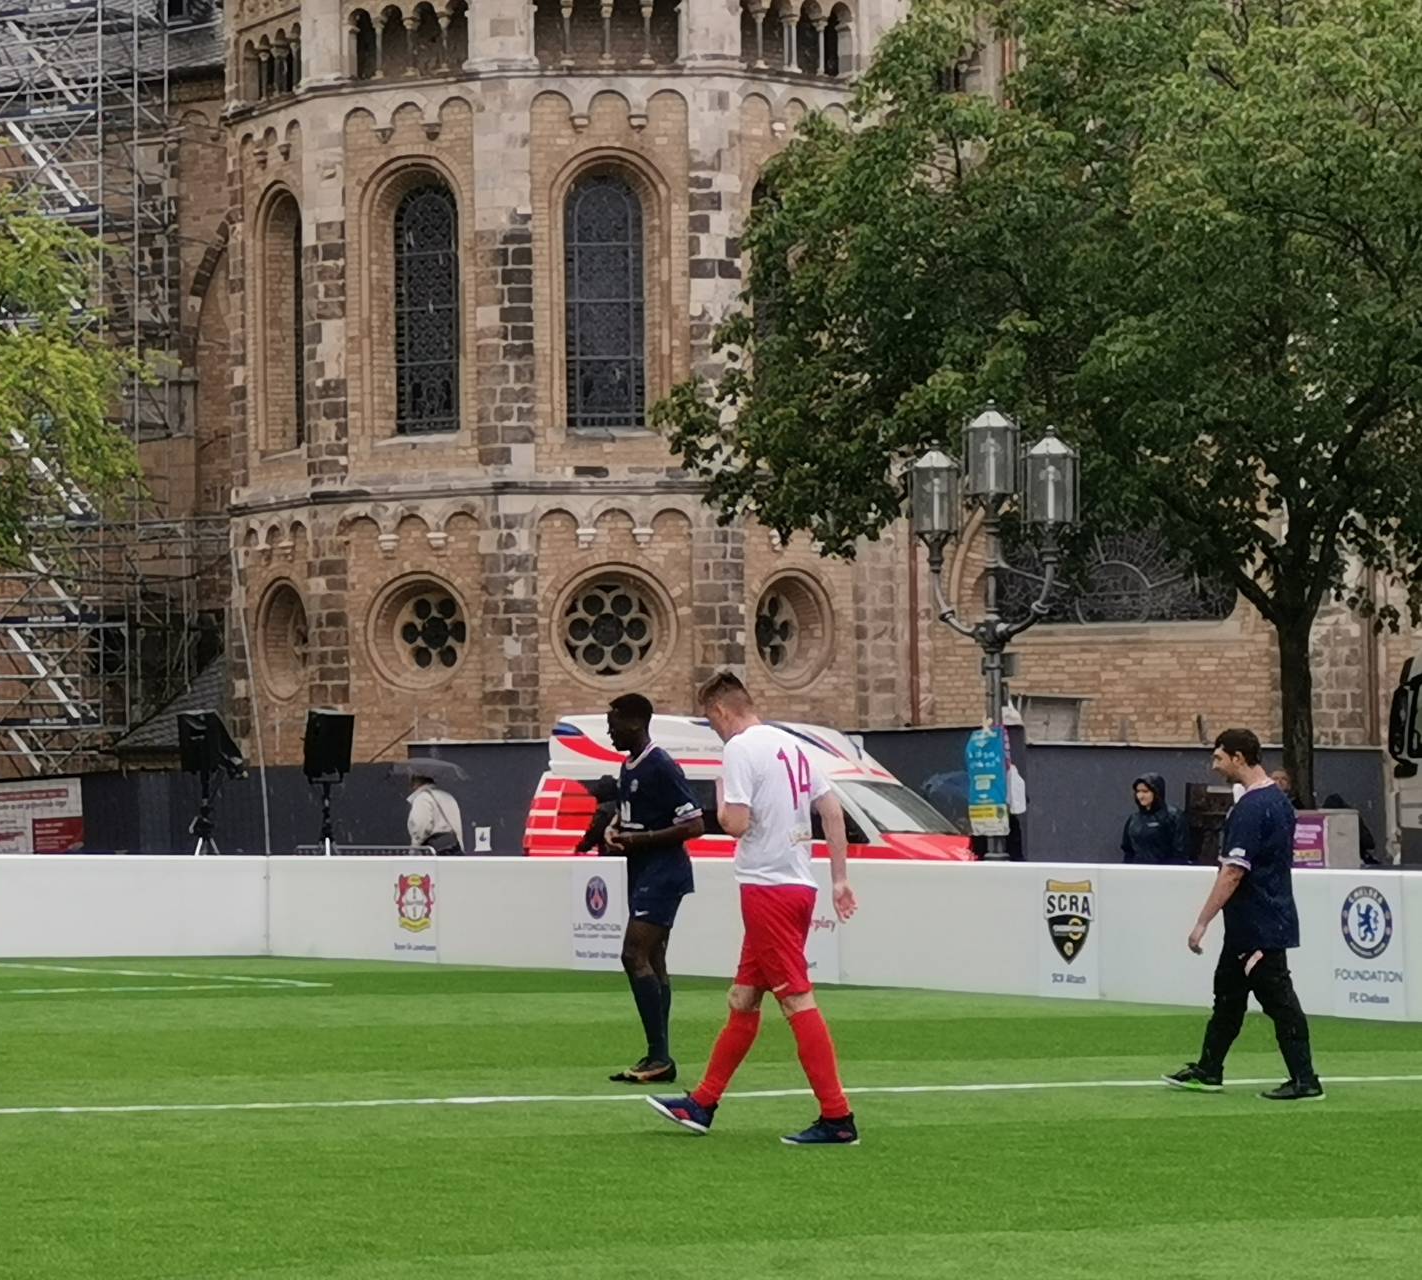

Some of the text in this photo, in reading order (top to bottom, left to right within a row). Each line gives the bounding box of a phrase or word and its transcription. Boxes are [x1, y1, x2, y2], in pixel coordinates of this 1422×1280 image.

[777, 745, 811, 810] 14
[1046, 894, 1091, 917] SCRA
[1348, 887, 1383, 904] CHELSEA
[1334, 968, 1403, 983] FOUNDATION
